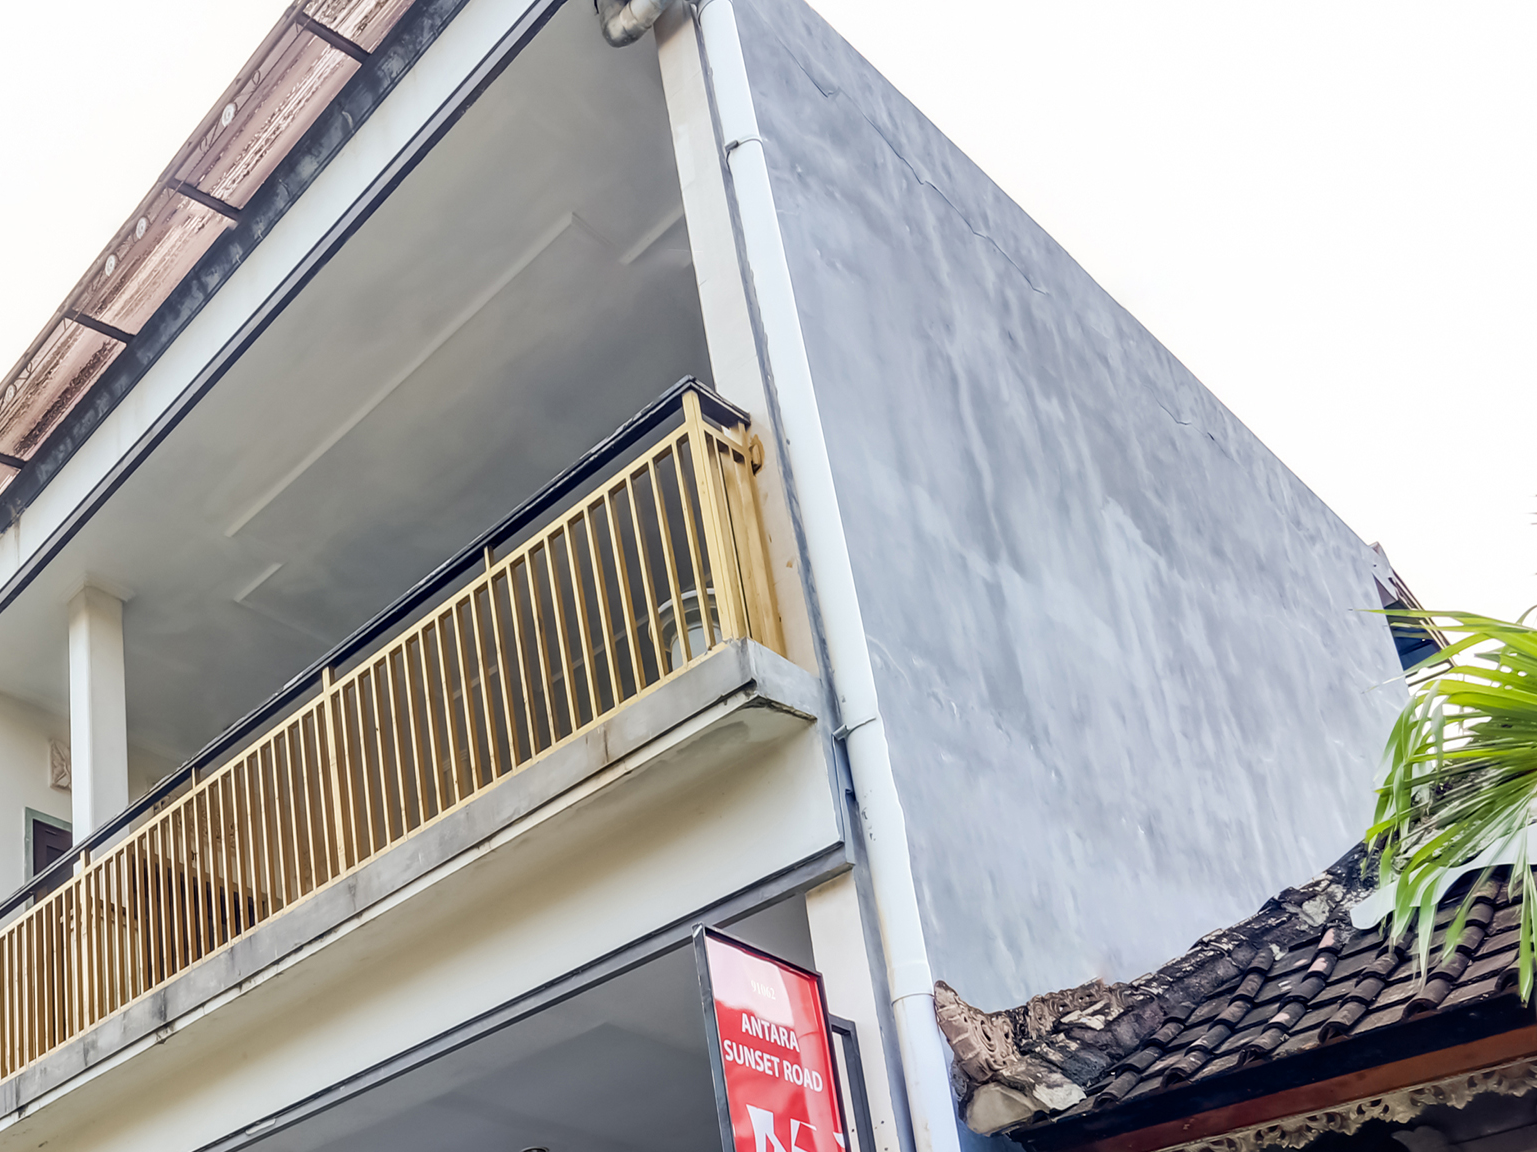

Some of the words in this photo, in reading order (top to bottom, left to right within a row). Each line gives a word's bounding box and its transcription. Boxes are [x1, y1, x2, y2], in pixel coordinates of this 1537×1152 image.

[750, 979, 776, 1000] 91062
[741, 1012, 801, 1053] ANTARA
[723, 1039, 780, 1078] SUNSET
[782, 1059, 824, 1092] ROAD
